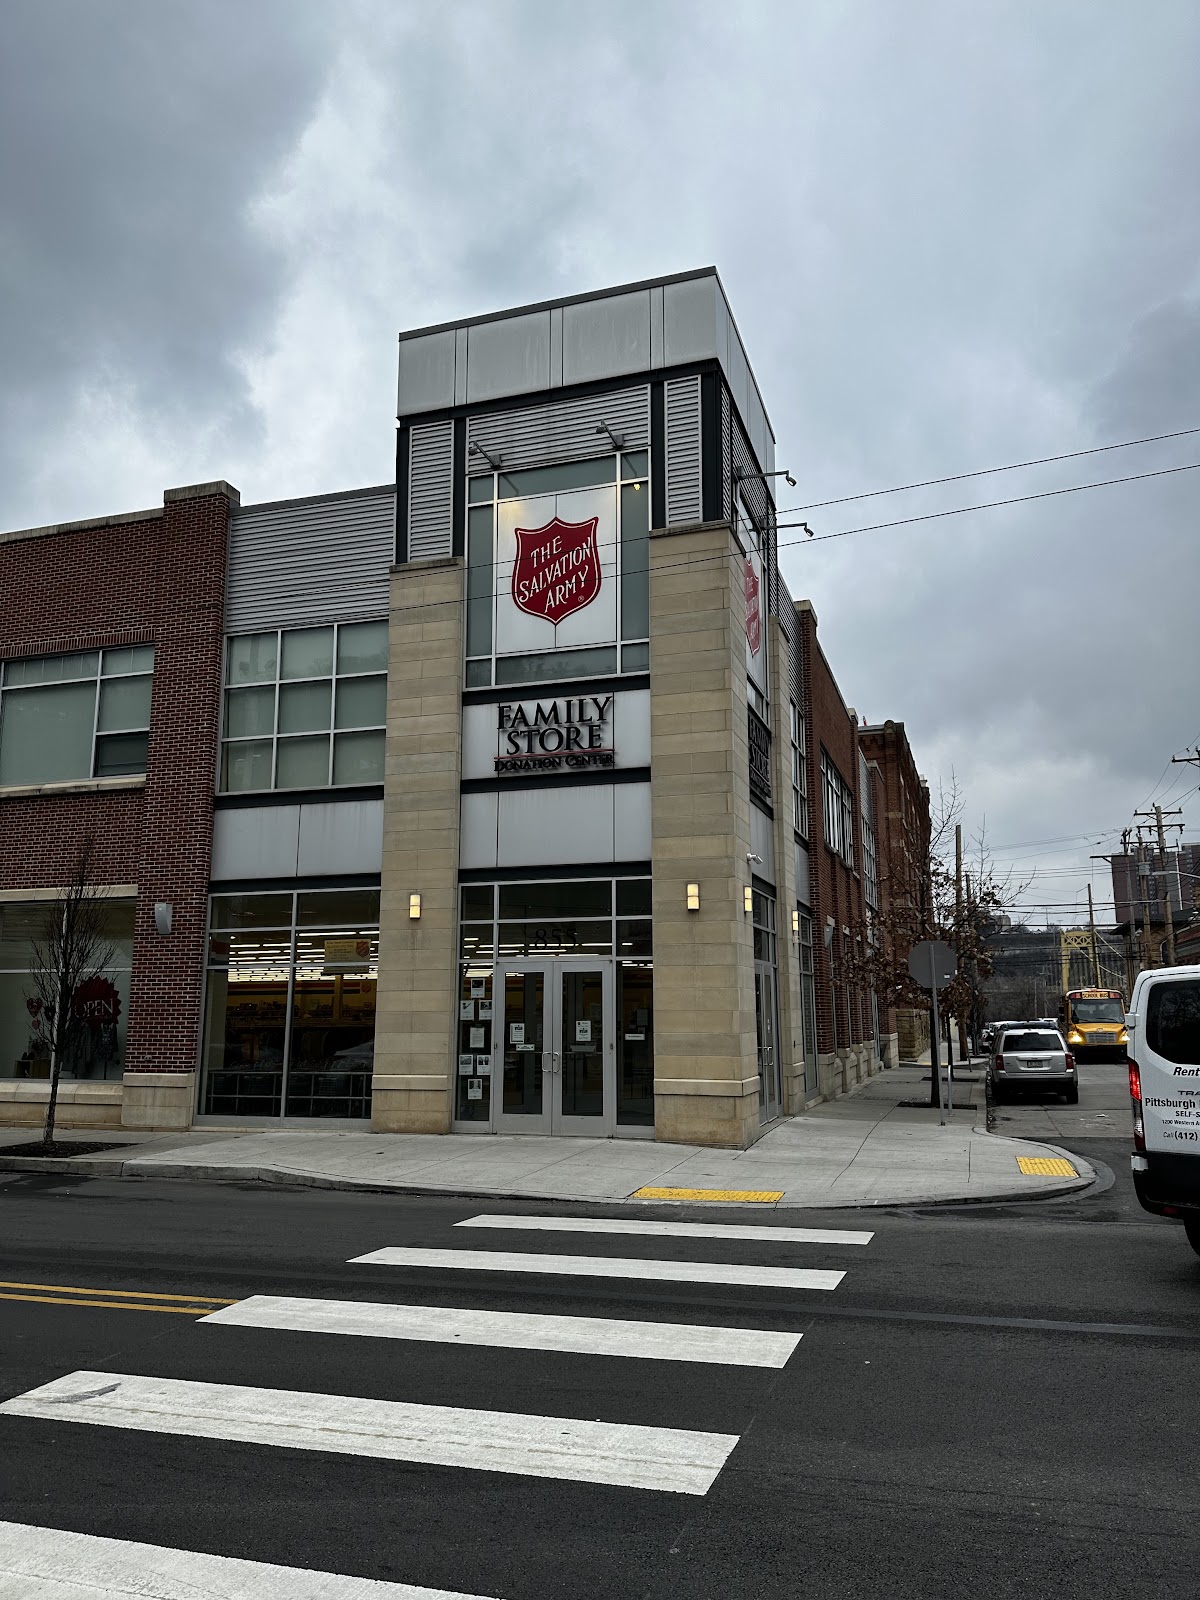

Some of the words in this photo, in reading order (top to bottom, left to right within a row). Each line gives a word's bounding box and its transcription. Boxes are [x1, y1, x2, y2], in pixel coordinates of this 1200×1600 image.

[531, 536, 562, 568] THE
[519, 537, 591, 602] SALVATION
[544, 565, 588, 613] ARMY
[497, 696, 613, 729] FAMILY
[507, 725, 602, 755] STORE
[494, 757, 561, 771] DONATION
[565, 753, 615, 767] CENTER
[535, 928, 577, 949] 855
[74, 998, 114, 1019] OPEN
[1173, 1066, 1200, 1077] Rent
[1145, 1097, 1196, 1110] Pittsburgh
[1175, 1110, 1200, 1118] SELF-S
[1174, 1130, 1198, 1142] (412)
